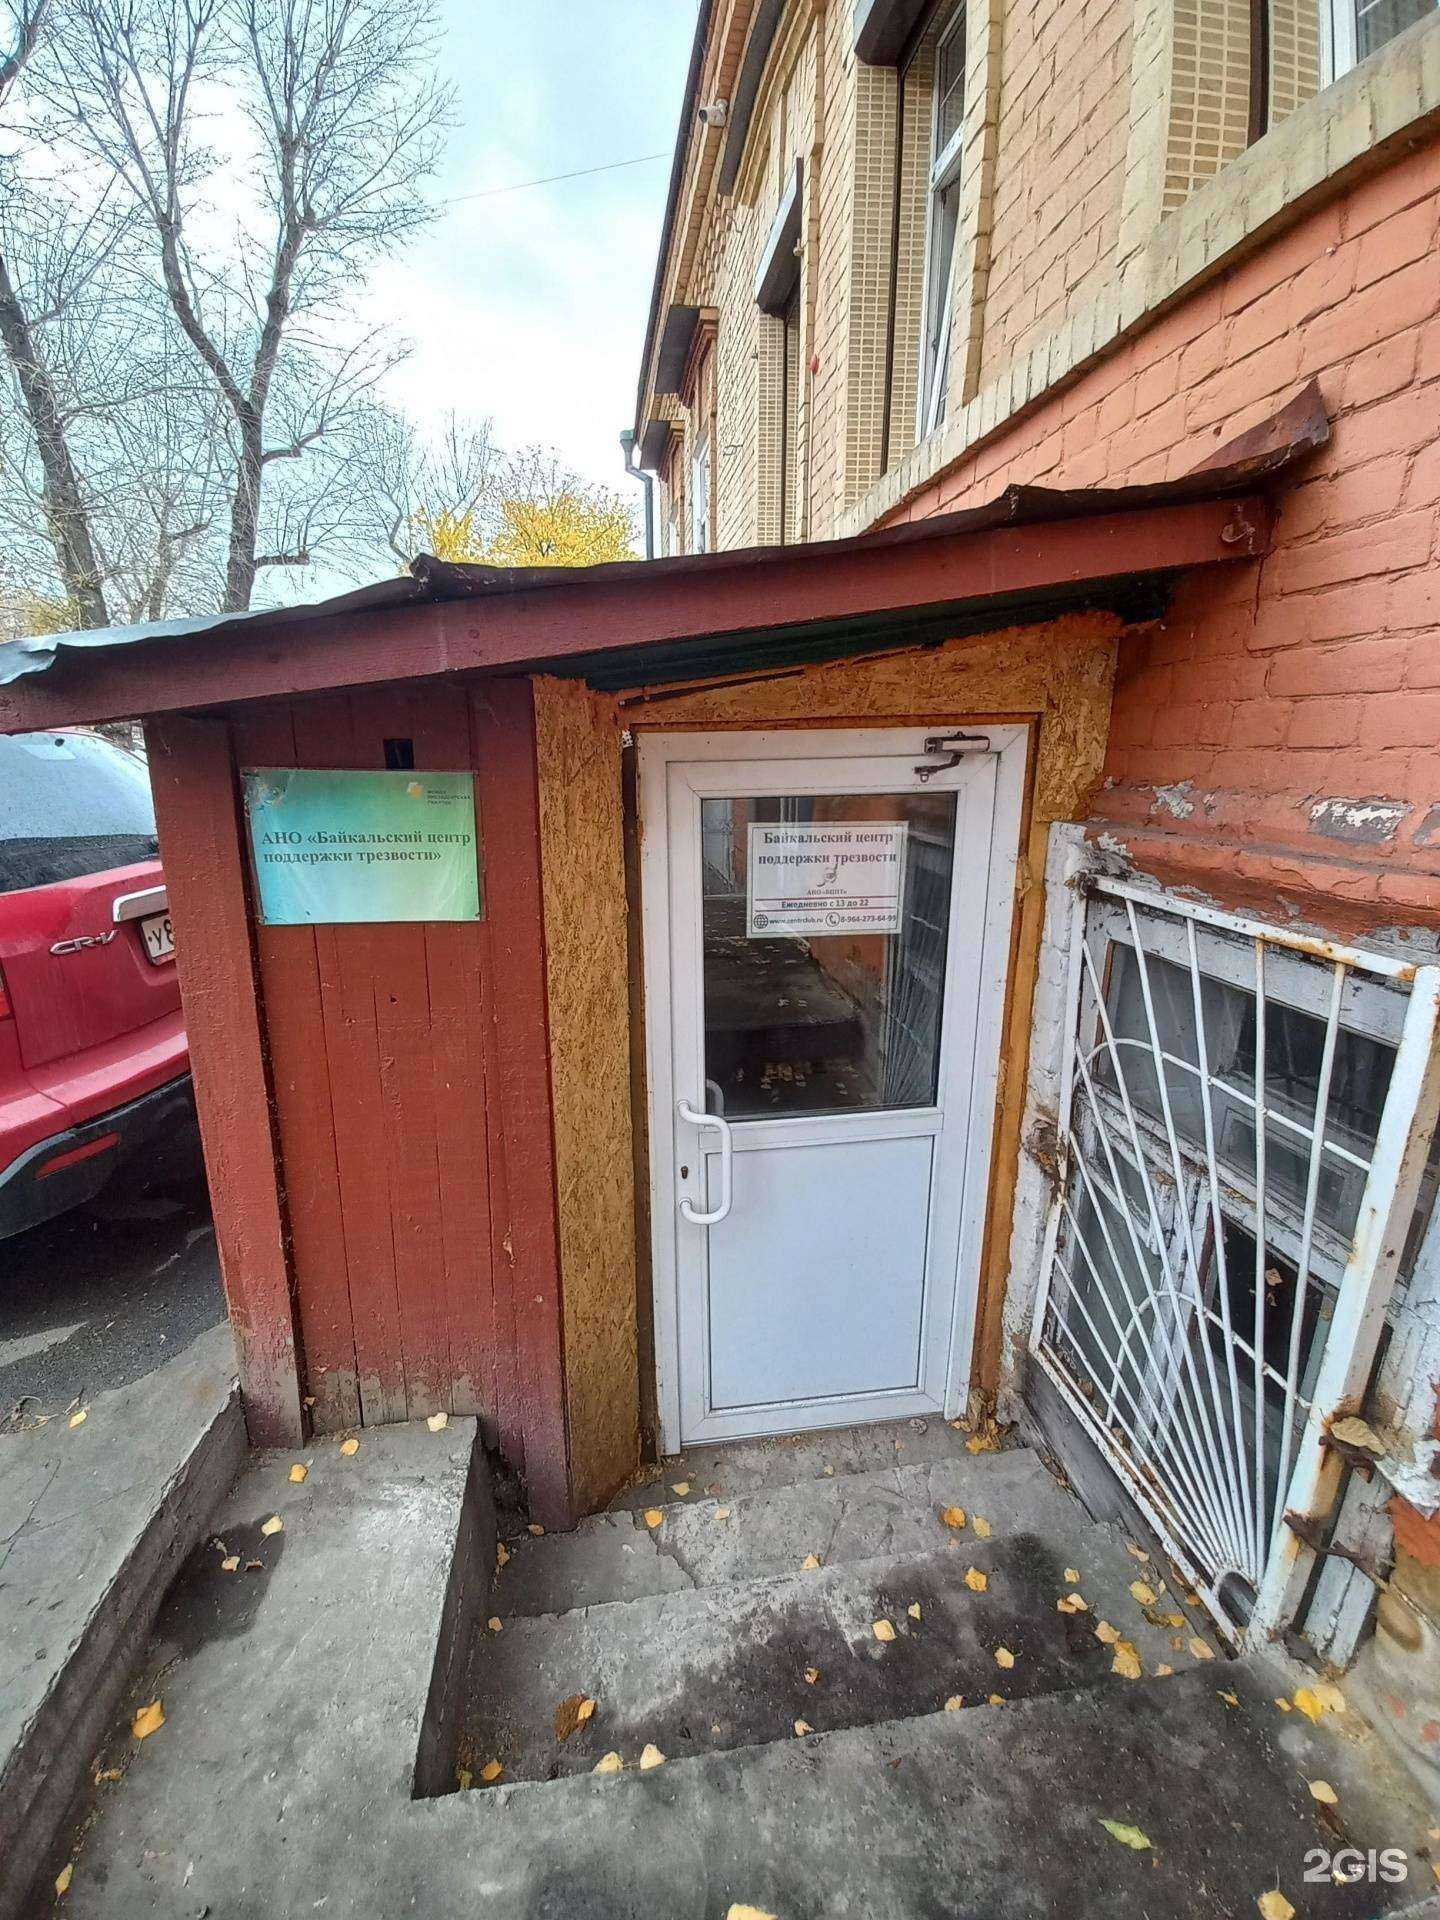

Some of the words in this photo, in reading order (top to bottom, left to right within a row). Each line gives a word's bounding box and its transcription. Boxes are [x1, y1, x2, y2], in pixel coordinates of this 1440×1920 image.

[262, 832, 302, 845] АНО
[307, 830, 423, 845] «Байкальский
[427, 832, 471, 846] центр
[764, 831, 852, 844] Байкальский
[856, 832, 893, 845] центр
[263, 851, 352, 865] поддержки
[358, 849, 441, 864] трезвости»
[758, 855, 830, 867] поддержки
[834, 853, 896, 866] трезвости
[50, 929, 117, 954] CR-V
